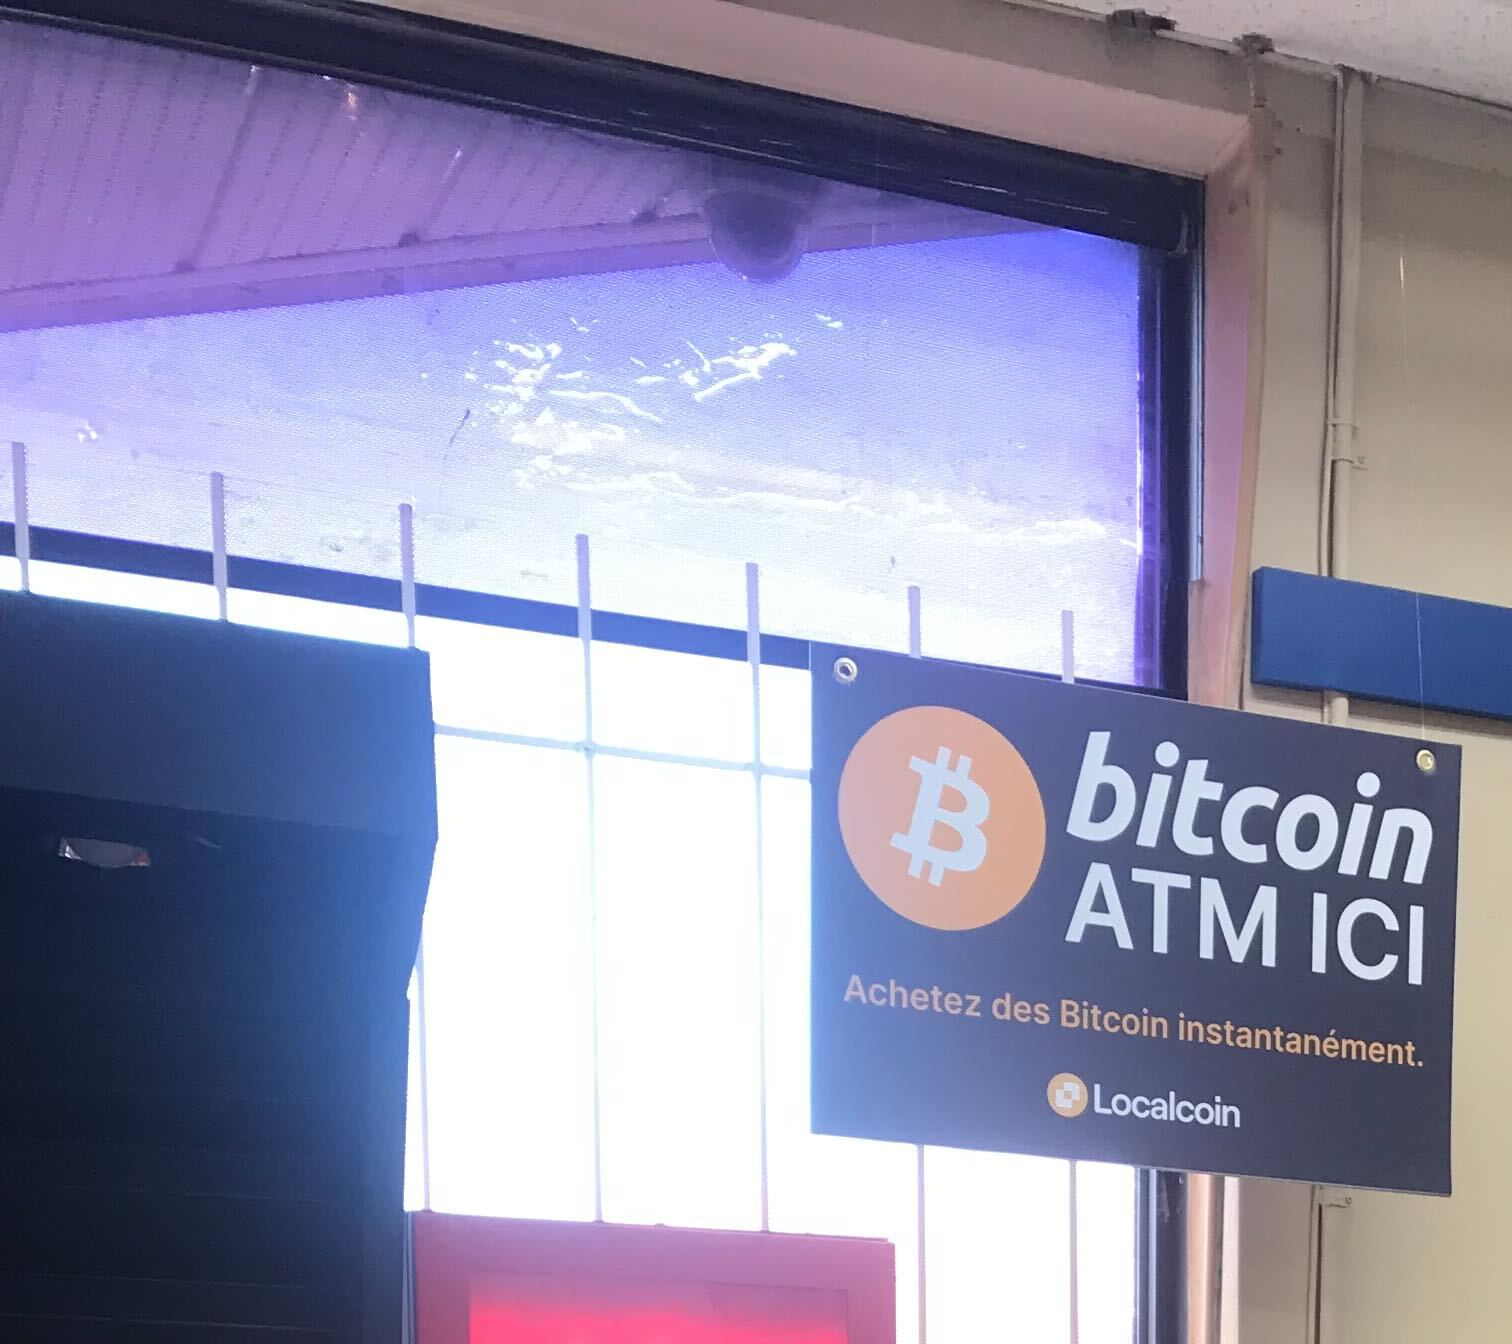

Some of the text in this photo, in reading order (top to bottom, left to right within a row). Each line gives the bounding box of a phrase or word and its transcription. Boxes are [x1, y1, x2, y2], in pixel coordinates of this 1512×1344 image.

[1065, 731, 1434, 885] bitcoin
[1064, 862, 1424, 986] ATM ICI
[843, 973, 1424, 1068] Achetez des Bitcoin instantanément.
[1093, 1084, 1242, 1128] Localcoin
